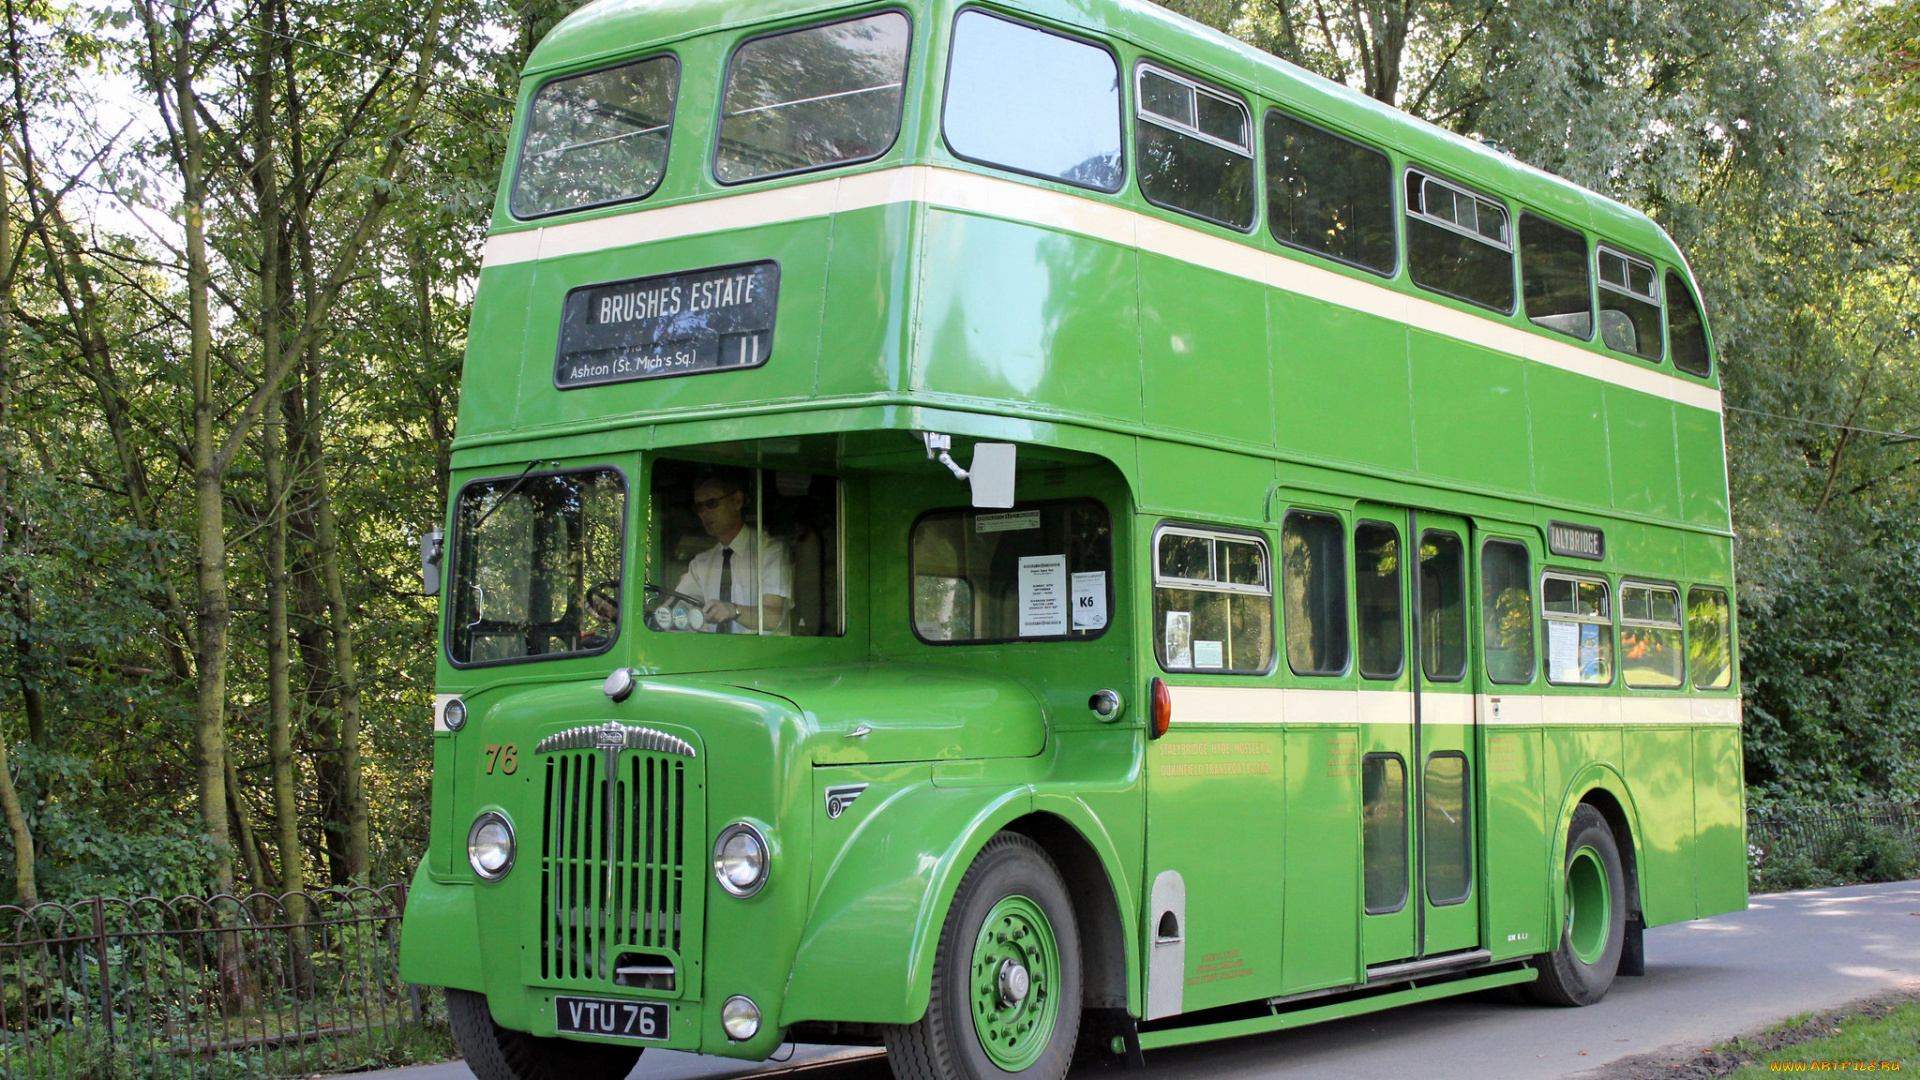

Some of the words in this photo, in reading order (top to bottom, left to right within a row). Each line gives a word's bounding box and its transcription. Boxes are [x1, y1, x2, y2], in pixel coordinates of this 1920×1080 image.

[600, 286, 681, 324] BRUSHES
[690, 274, 756, 312] ESTATE
[570, 364, 609, 379] Ashton
[612, 359, 633, 374] (St.
[636, 354, 672, 371] Mich's
[675, 349, 697, 368] Sq.)
[1080, 596, 1094, 608] K6
[486, 743, 518, 775] 76
[1160, 764, 1203, 776] DUKINFIELD
[1205, 763, 1245, 775] TRANSPORT
[569, 1001, 615, 1031] VTU
[623, 1005, 655, 1035] 76
